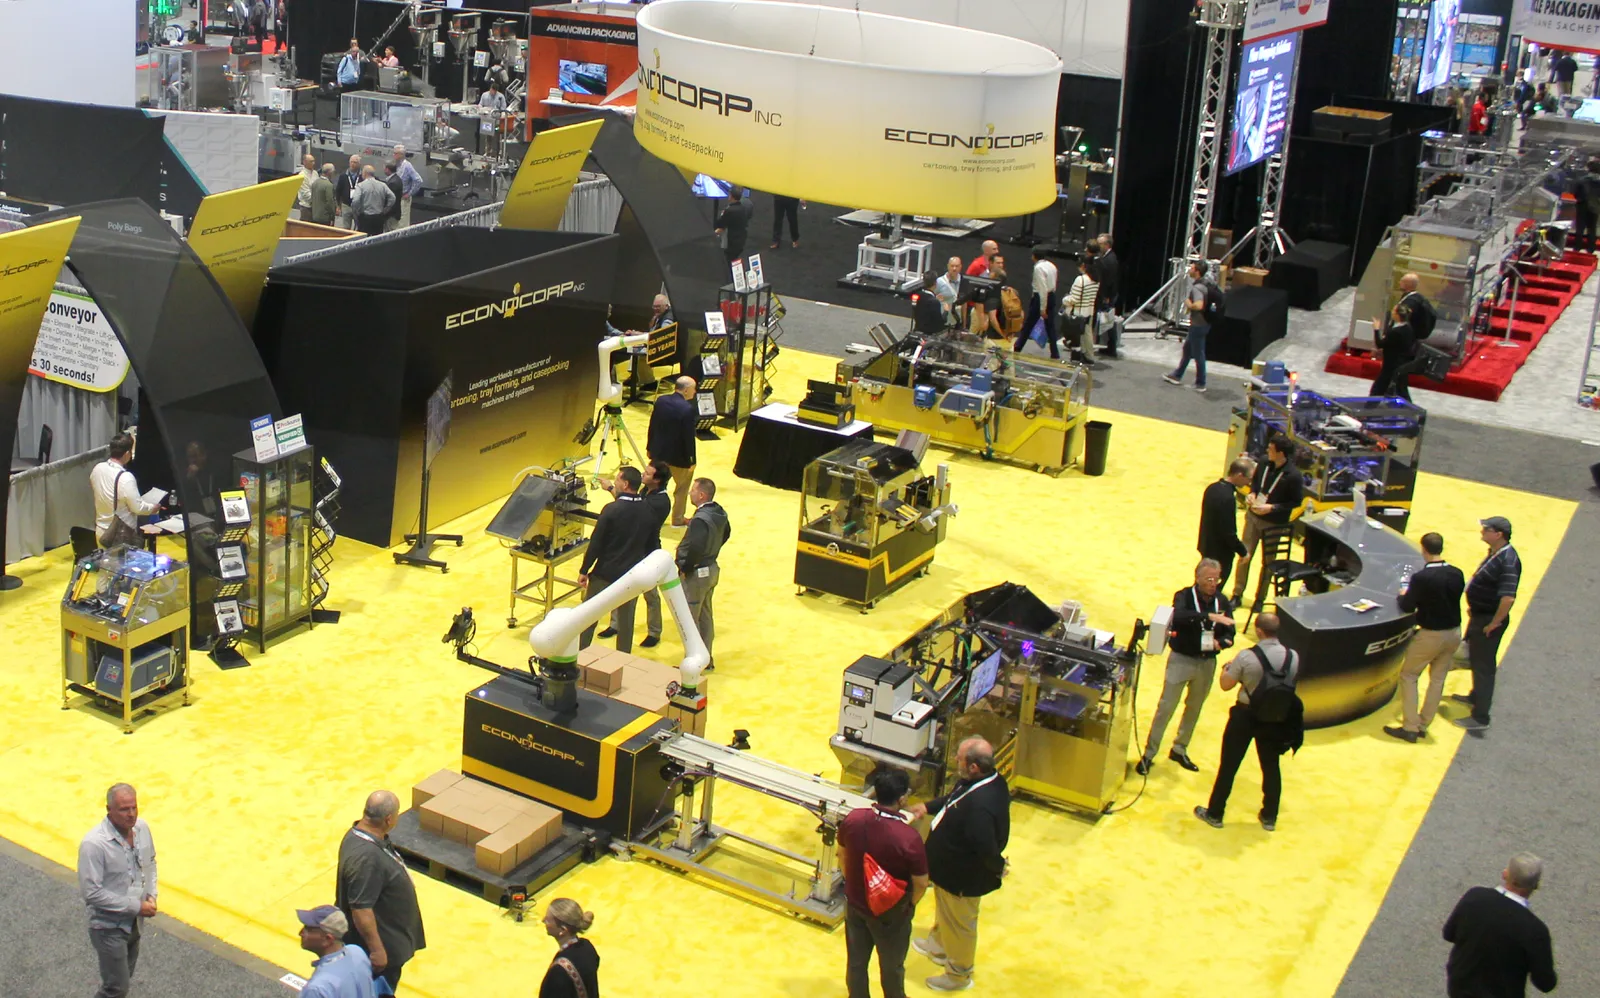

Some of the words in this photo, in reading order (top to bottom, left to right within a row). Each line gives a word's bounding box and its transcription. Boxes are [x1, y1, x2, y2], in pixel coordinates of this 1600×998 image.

[546, 23, 591, 35] ADVANCING
[590, 27, 636, 40] PACKAGING
[754, 109, 782, 127] INC
[670, 132, 680, 145] and
[680, 136, 724, 163] casepacking
[885, 127, 1044, 149] ECONOCORP
[107, 221, 123, 233] Poly
[124, 222, 143, 235] Bags
[200, 210, 278, 237] ECONOCORP
[445, 281, 575, 330] ECONOCORP
[572, 282, 586, 293] INC
[39, 357, 52, 372] 30
[53, 363, 96, 385] seconds!
[468, 377, 489, 392] Leading
[489, 369, 514, 384] worldwide
[513, 358, 546, 377] manufacturer
[545, 354, 552, 364] of
[479, 386, 495, 399] tray
[493, 377, 520, 394] forming,
[520, 371, 533, 383] and
[533, 360, 570, 380] casepacking
[481, 394, 505, 410] machines
[505, 390, 515, 400] and
[514, 384, 535, 398] systems
[1364, 626, 1414, 655] ECO
[481, 723, 576, 761] ECONOCORP
